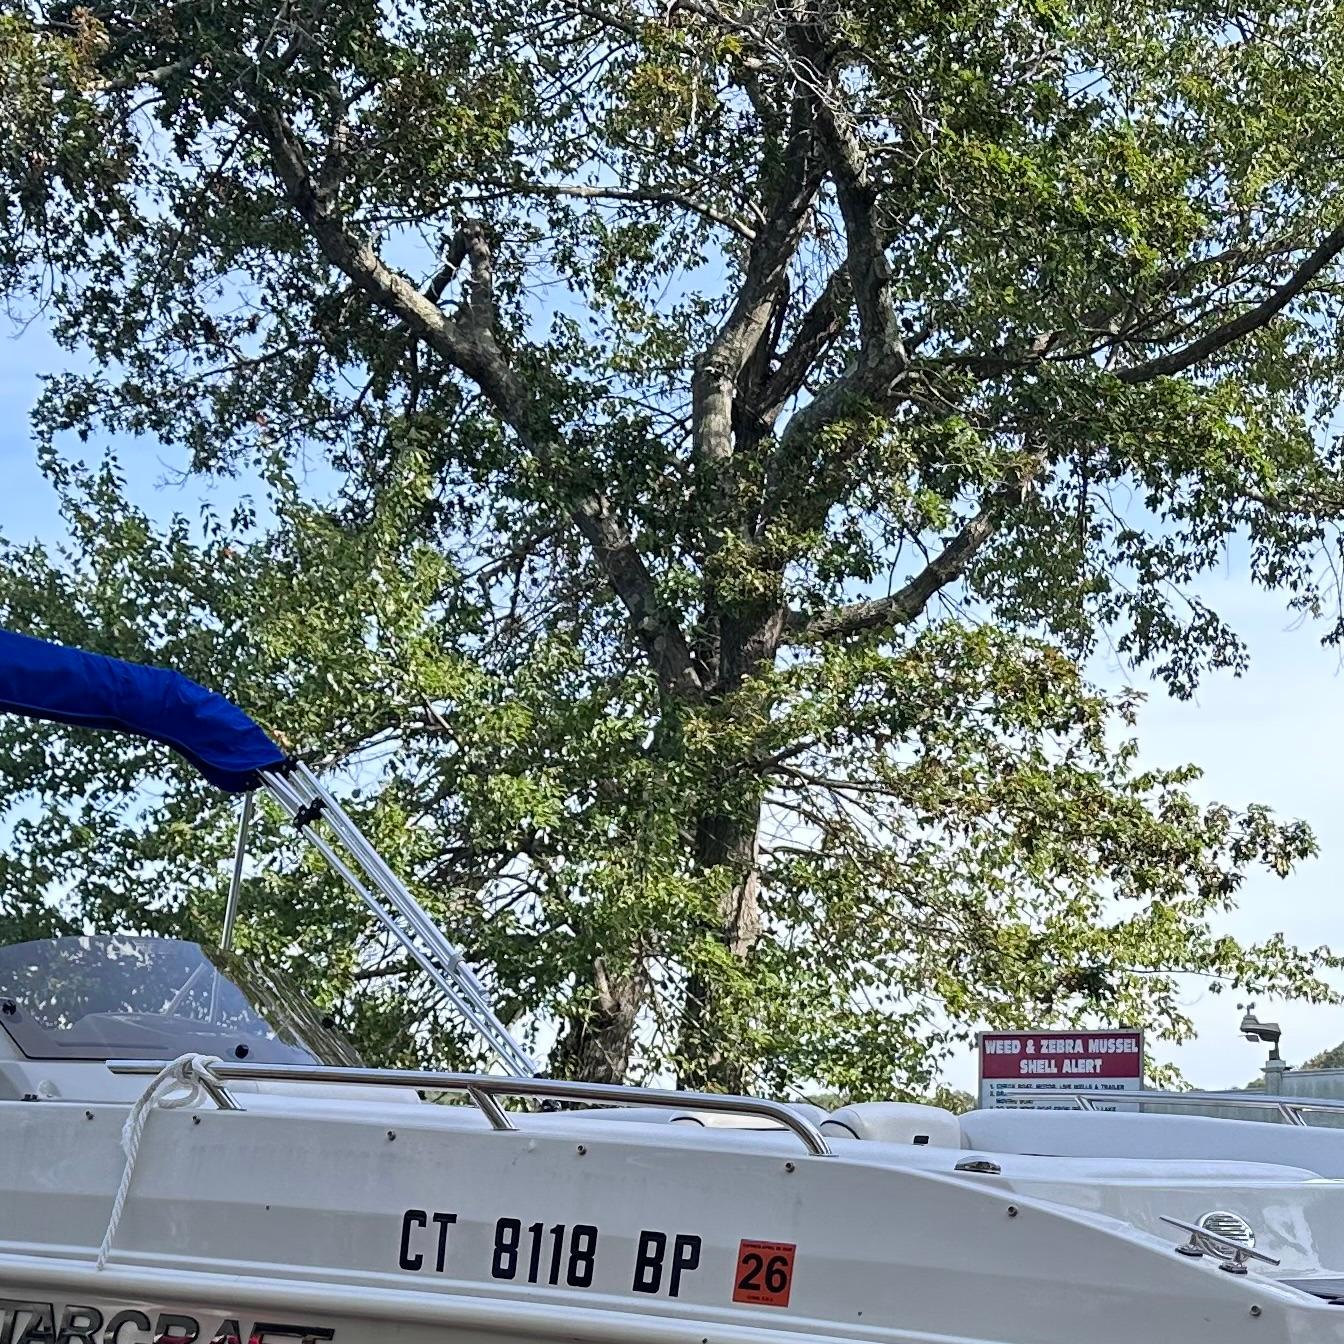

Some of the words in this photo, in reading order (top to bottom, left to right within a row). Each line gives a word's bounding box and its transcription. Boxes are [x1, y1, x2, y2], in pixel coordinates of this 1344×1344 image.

[985, 1040, 1021, 1054] WEED
[1026, 1039, 1035, 1054] &
[1041, 1039, 1084, 1054] ZEBRA
[1089, 1039, 1138, 1054] MUSSEL
[1020, 1059, 1057, 1074] SHELL
[1063, 1059, 1102, 1073] ALERT
[399, 1209, 458, 1273] CT
[491, 1217, 598, 1288] 8118
[632, 1230, 702, 1297] BP
[738, 1253, 788, 1293] 26
